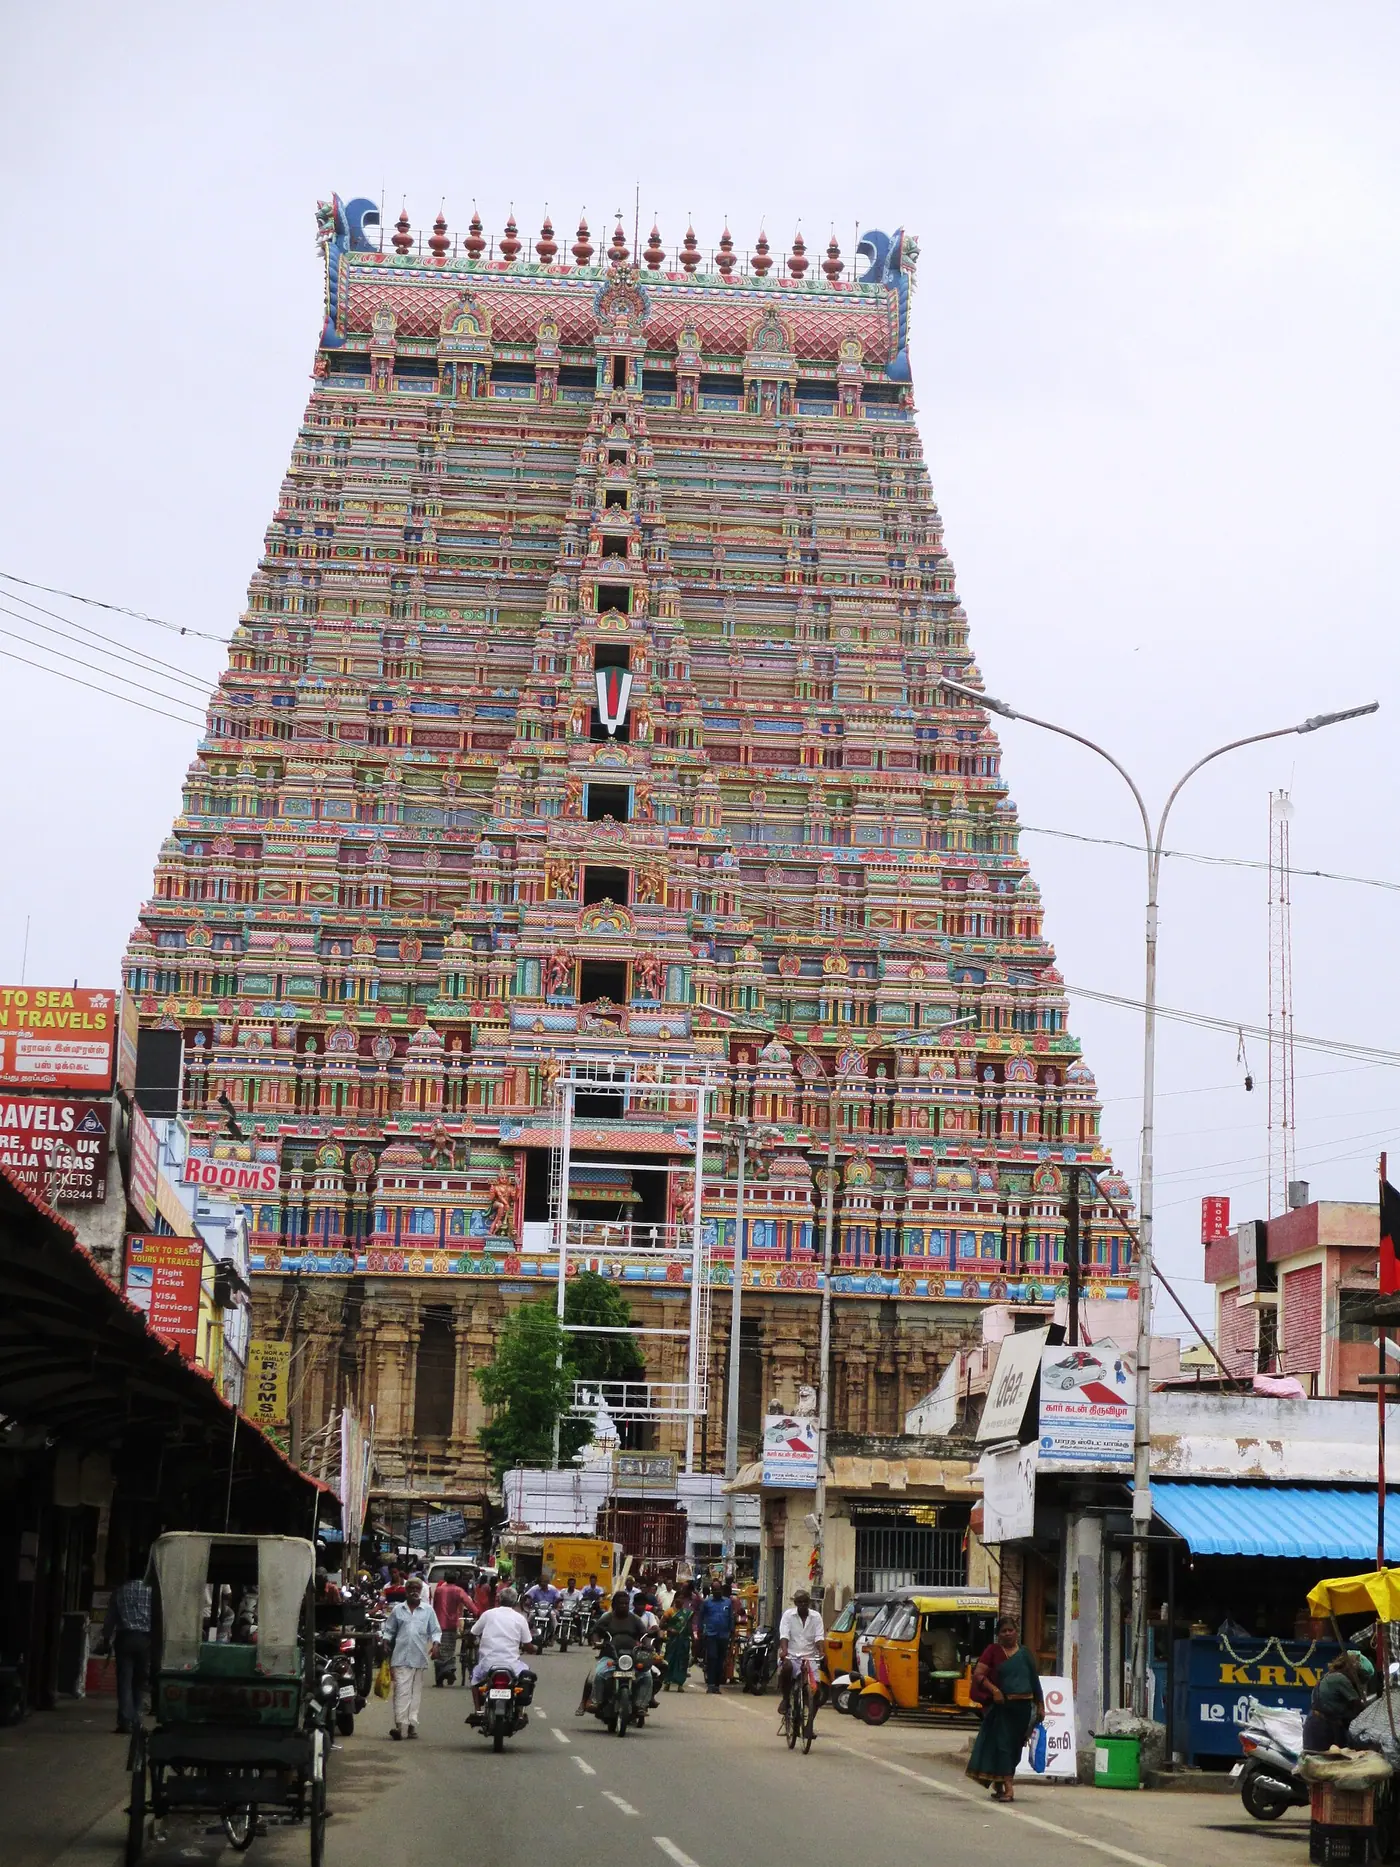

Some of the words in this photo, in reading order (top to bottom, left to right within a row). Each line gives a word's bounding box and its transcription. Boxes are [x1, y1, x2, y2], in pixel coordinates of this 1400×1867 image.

[2, 990, 28, 1007] TO
[35, 991, 74, 1008] SEA
[16, 1010, 107, 1030] TRAVELS
[34, 1061, 51, 1069] பஸ்
[0, 1103, 75, 1132] AVELS
[77, 1140, 100, 1153] UK
[45, 1154, 95, 1170] VISAS
[184, 1157, 277, 1191] ROOMS
[145, 1244, 161, 1253] SKY
[162, 1246, 173, 1254] TO
[174, 1247, 189, 1255] SEA
[132, 1254, 157, 1264] TOURS
[167, 1257, 200, 1267] TRAVELS
[157, 1268, 183, 1278] Flight
[156, 1278, 184, 1287] Ticket
[155, 1292, 177, 1301] VISA
[154, 1302, 193, 1312] Services
[153, 1314, 181, 1323] Travel
[258, 1361, 278, 1413] ROOMS
[1045, 1403, 1063, 1413] கார்
[1064, 1405, 1087, 1414] கடன்
[1047, 1731, 1072, 1750] காபி
